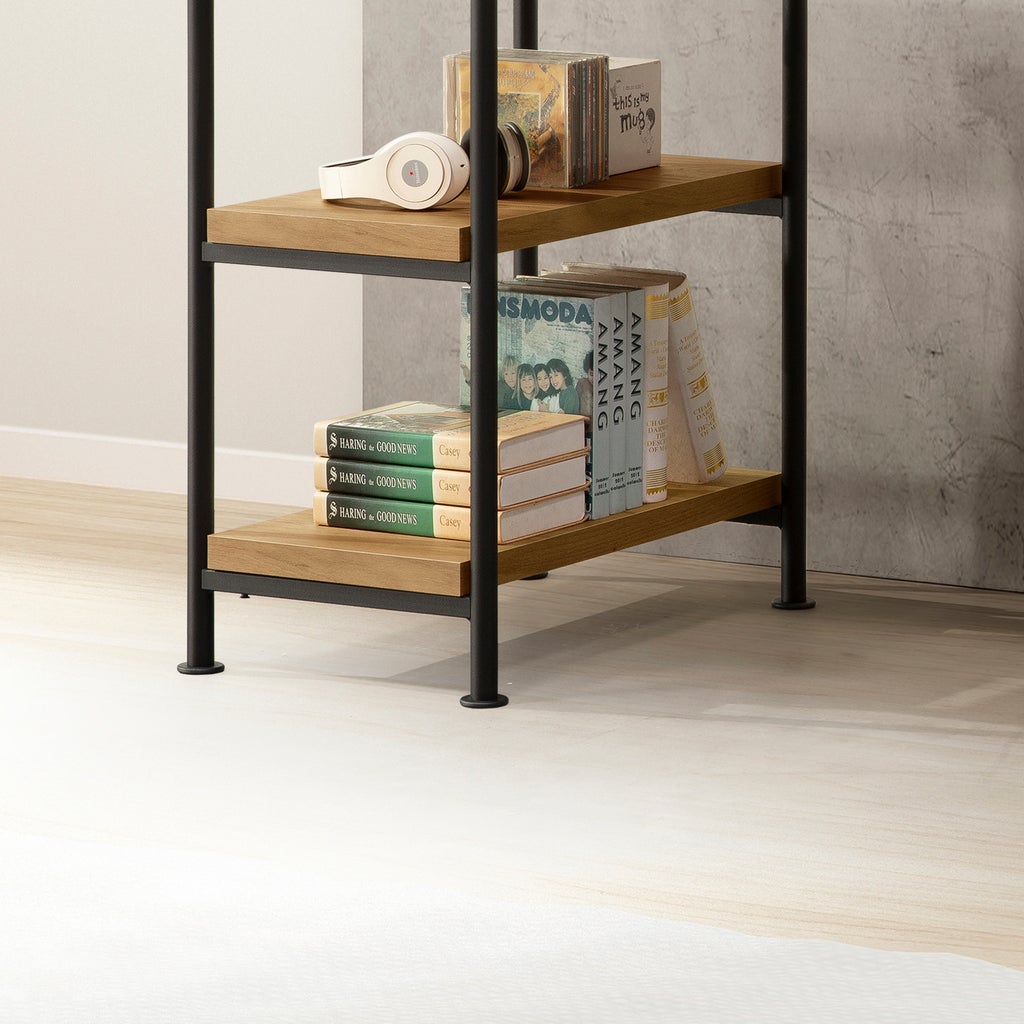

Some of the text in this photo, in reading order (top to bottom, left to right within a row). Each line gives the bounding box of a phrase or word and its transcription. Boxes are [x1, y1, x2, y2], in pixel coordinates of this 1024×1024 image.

[613, 92, 650, 110] this is my
[613, 317, 624, 425] AMANG
[630, 312, 642, 420] AMANG
[597, 321, 608, 431] AMANG
[439, 444, 460, 459] Casey
[439, 480, 460, 495] Casey
[439, 514, 461, 530] Casey
